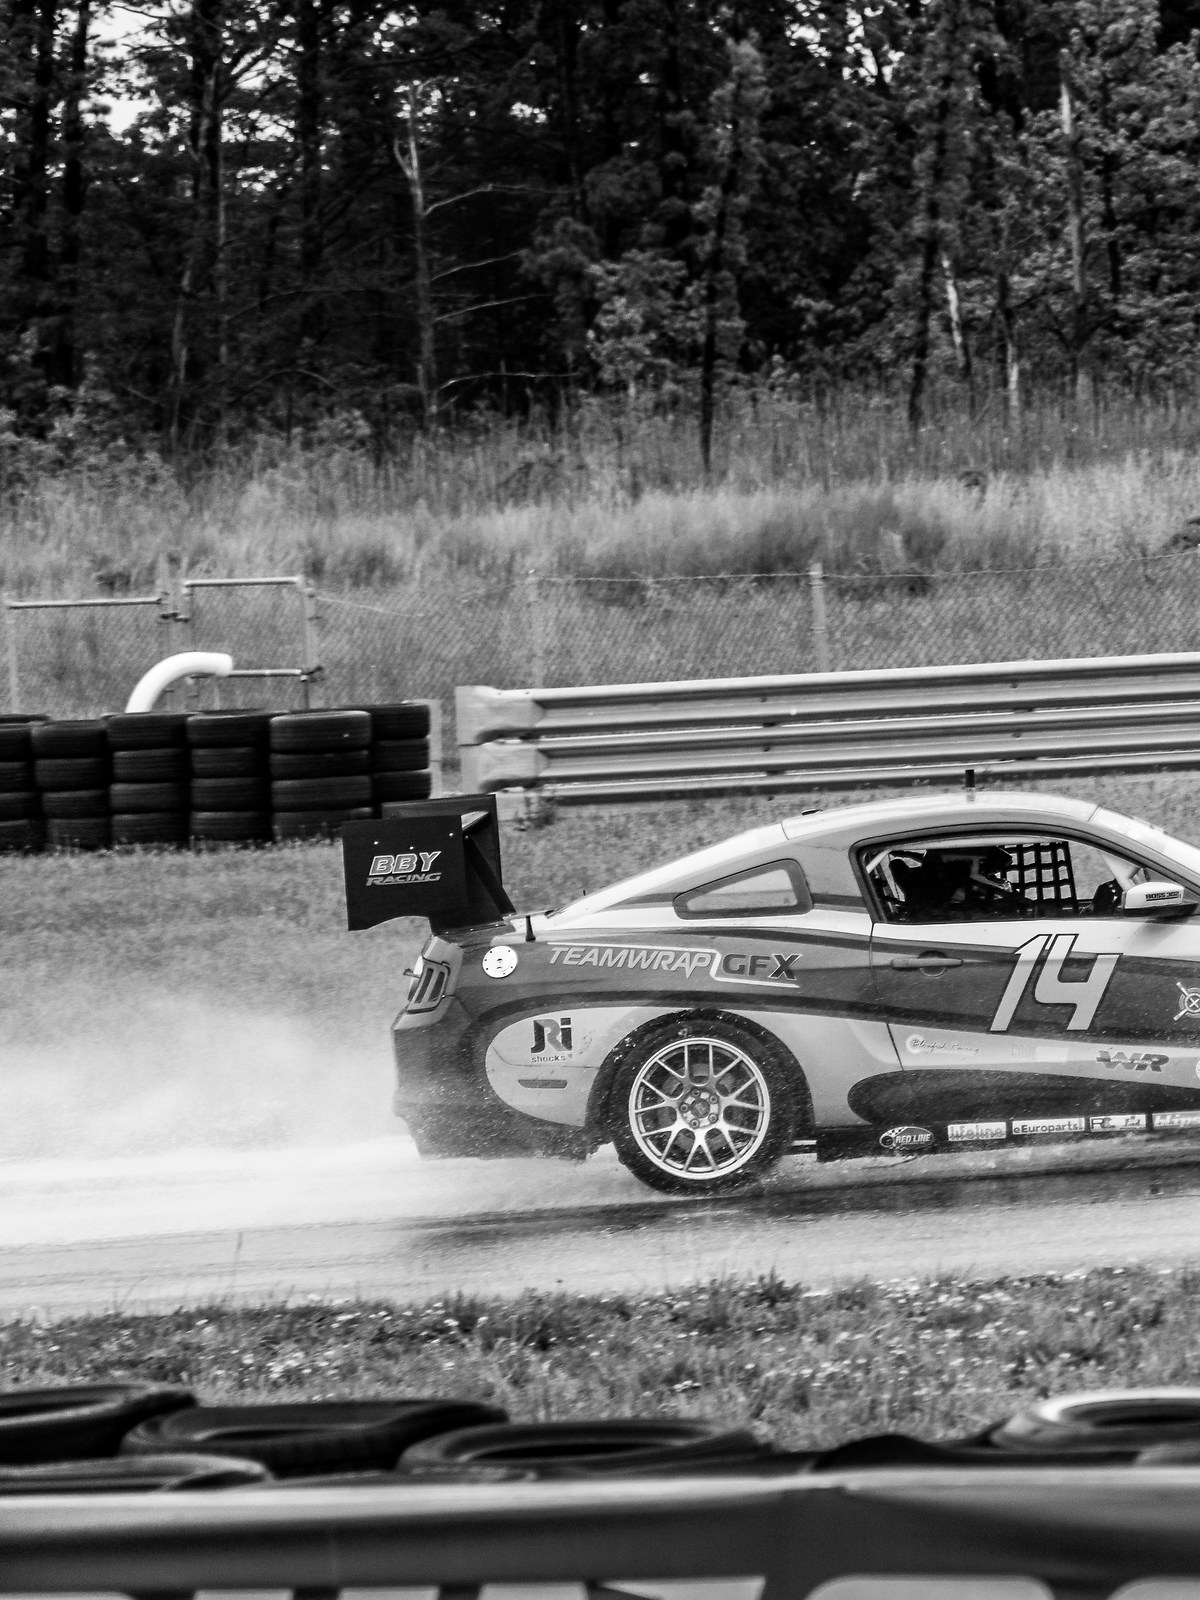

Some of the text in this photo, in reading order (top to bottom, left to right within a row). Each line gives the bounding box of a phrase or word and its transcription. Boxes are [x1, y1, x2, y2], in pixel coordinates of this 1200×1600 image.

[368, 850, 442, 876] BBY
[365, 872, 442, 887] RACING
[549, 947, 803, 981] TEAMWRAP GFX
[989, 933, 1124, 1032] 14
[531, 1054, 566, 1063] shocks
[895, 1133, 931, 1144] RED LINE
